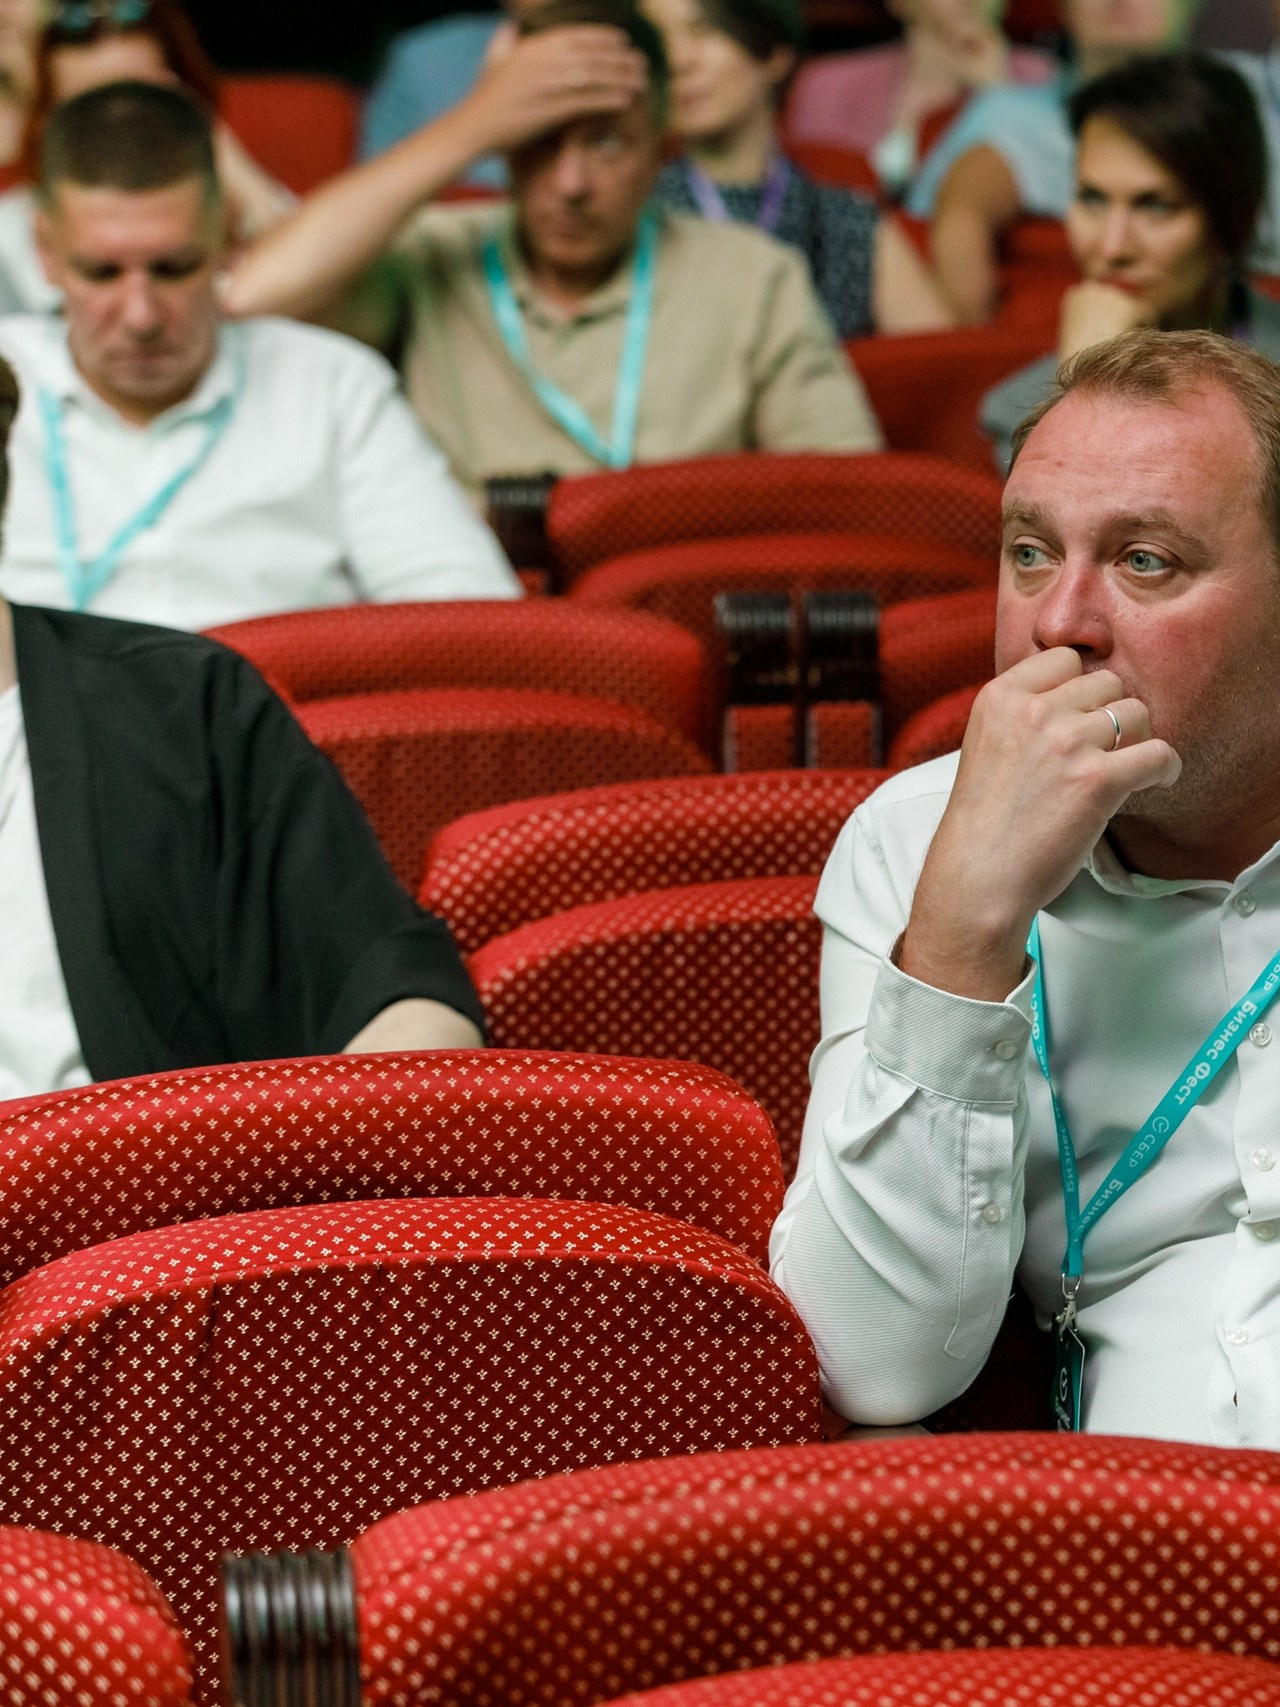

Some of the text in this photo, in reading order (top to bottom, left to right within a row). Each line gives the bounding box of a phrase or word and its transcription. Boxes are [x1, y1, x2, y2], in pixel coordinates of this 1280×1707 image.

[1206, 1001, 1258, 1060] Бизнес
[1174, 1062, 1211, 1105] Фест
[1060, 1124, 1075, 1192] Бизнес
[1129, 1134, 1156, 1168] СБЕР
